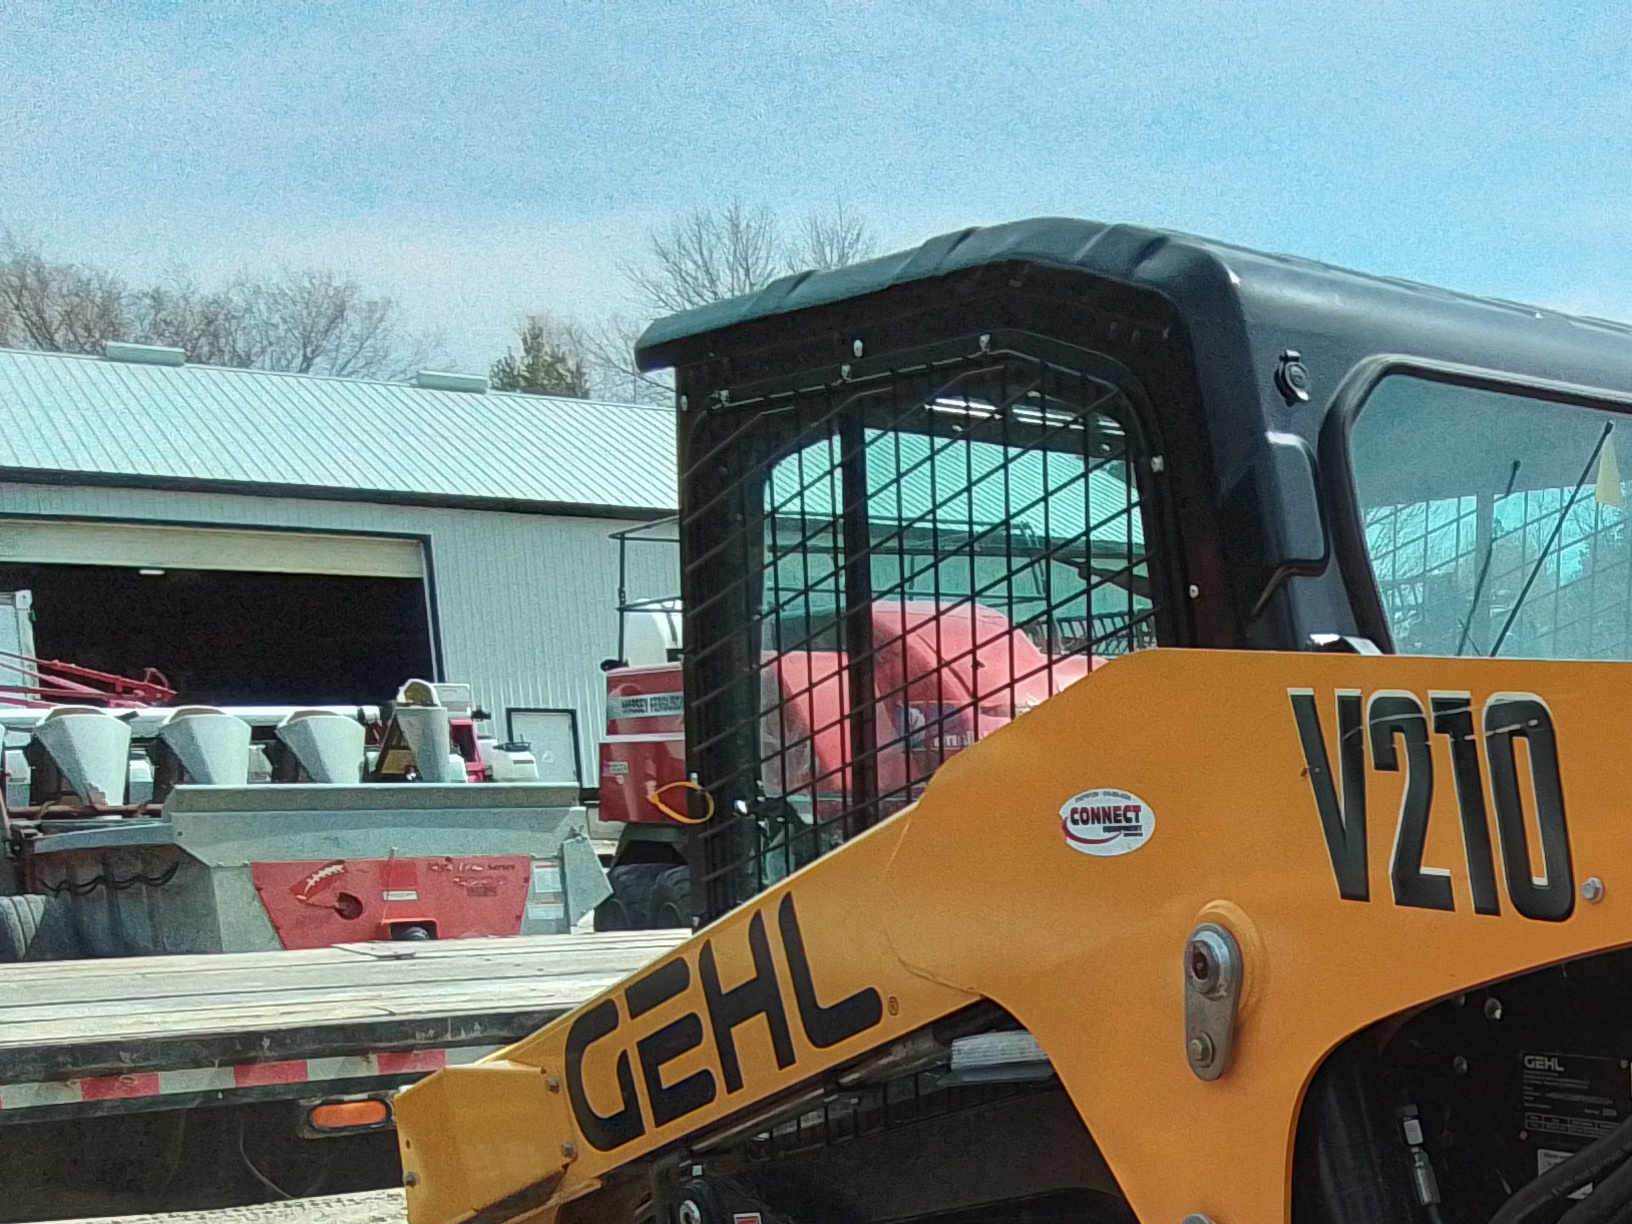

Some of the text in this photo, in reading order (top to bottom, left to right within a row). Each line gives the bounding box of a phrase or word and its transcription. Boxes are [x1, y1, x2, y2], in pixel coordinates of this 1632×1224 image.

[1070, 805, 1142, 826] CONNECT
[1287, 687, 1576, 923] V210
[565, 891, 883, 1152] GEHL
[1523, 1055, 1566, 1072] GEHL
